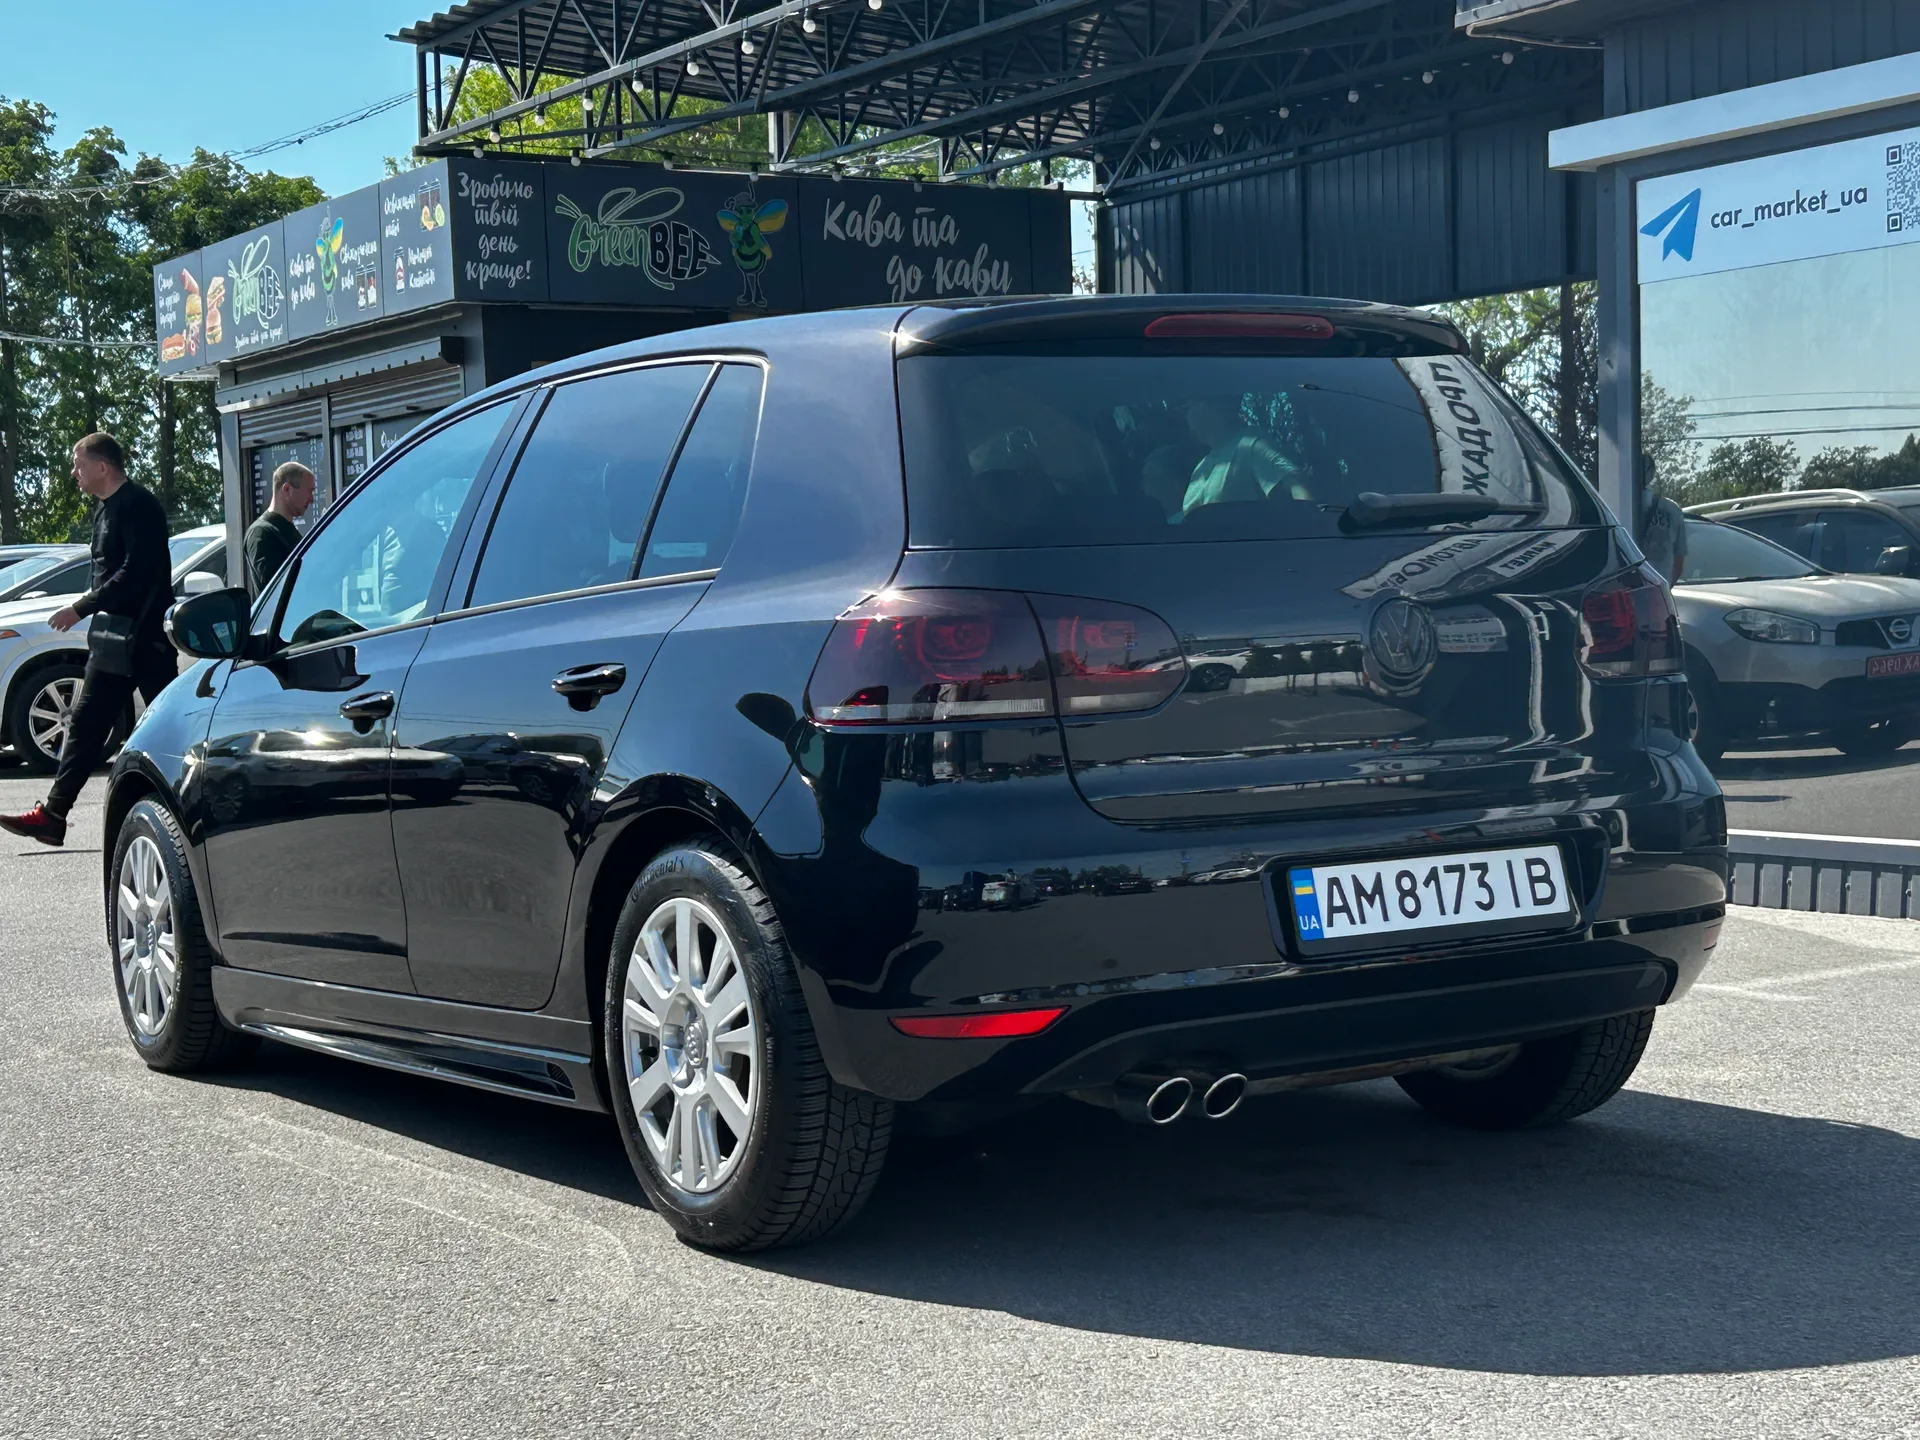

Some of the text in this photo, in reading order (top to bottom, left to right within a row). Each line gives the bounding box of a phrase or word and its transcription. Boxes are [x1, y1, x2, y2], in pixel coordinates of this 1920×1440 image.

[457, 172, 534, 207] Зробимо
[475, 200, 519, 227] твій
[823, 194, 960, 248] Кава та
[1711, 187, 1868, 228] car_market_ua
[478, 232, 519, 260] день
[465, 259, 534, 290] краще!
[886, 243, 1013, 303] до кави
[1326, 857, 1557, 927] AM 8173 IB
[1299, 914, 1321, 931] UA
